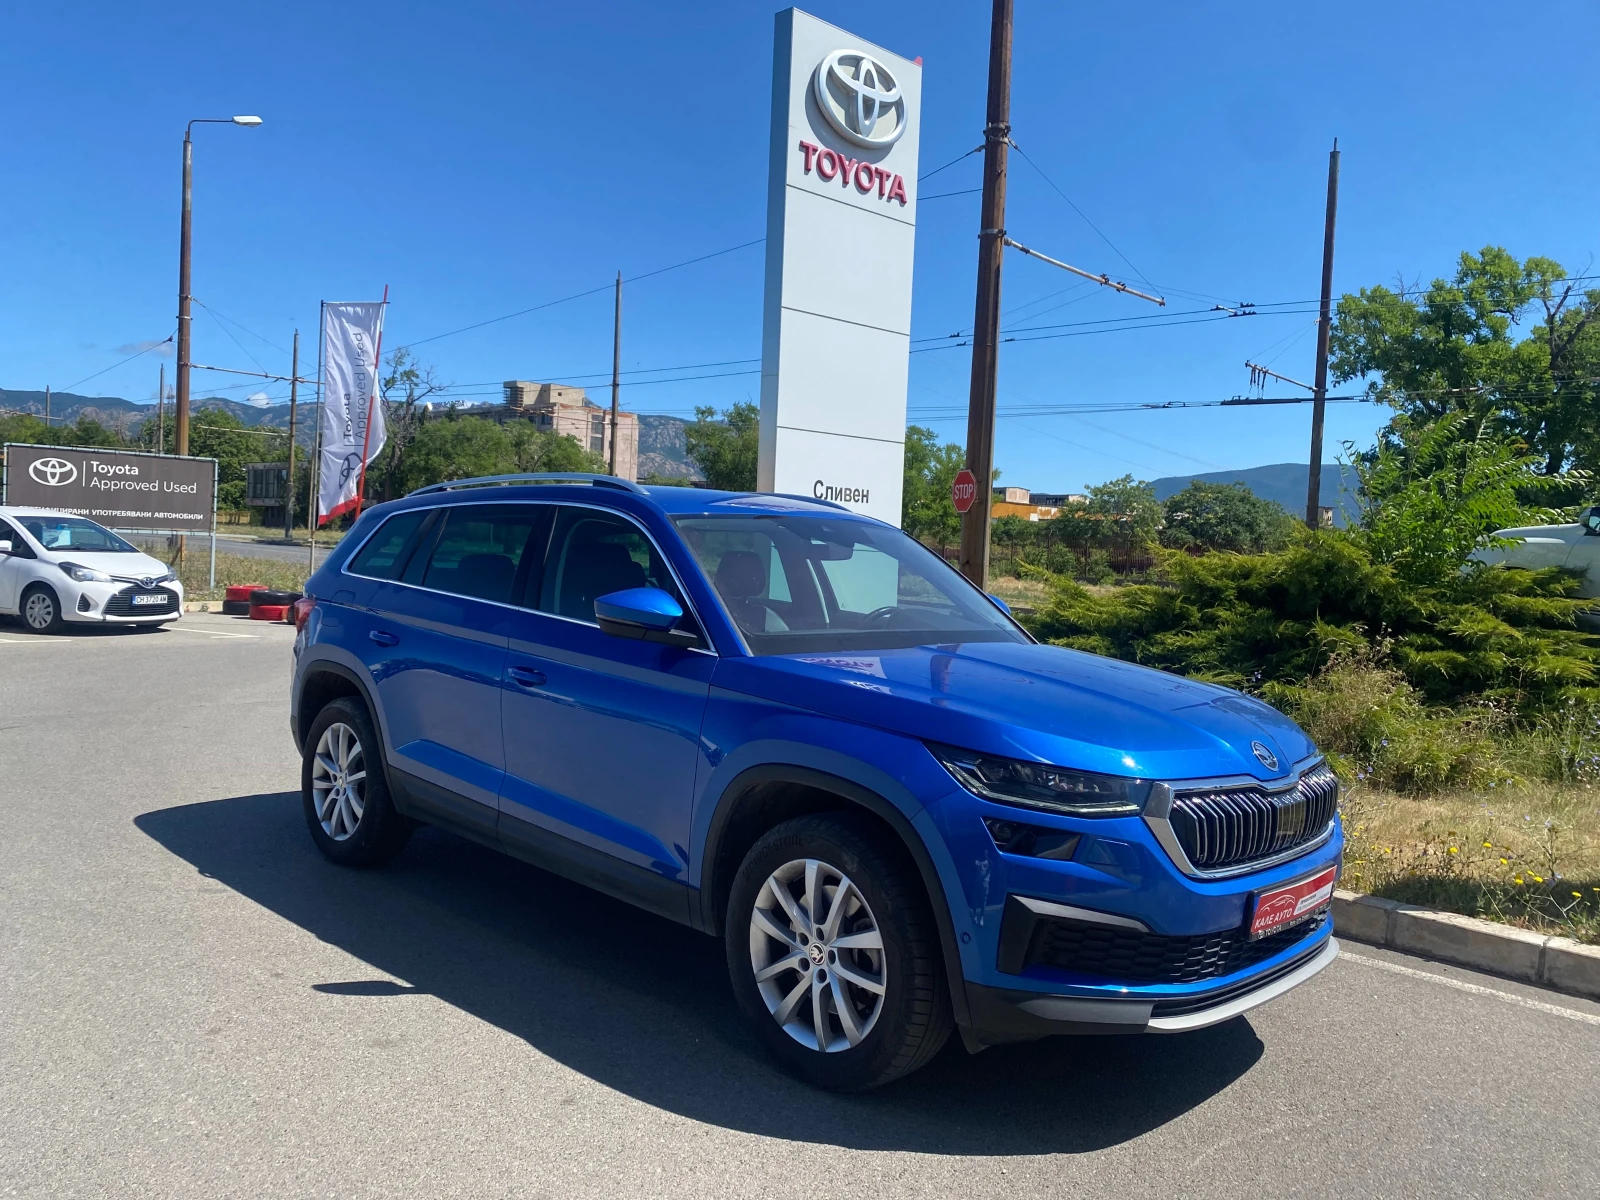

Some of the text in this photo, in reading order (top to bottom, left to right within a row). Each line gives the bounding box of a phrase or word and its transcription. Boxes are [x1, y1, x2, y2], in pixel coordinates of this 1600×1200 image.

[799, 139, 907, 205] TOYOTA
[353, 332, 367, 440] Approved Used
[343, 393, 352, 440] Toyota
[90, 461, 139, 476] Toyota
[89, 479, 197, 494] Approved Used
[813, 479, 870, 504] Сливен
[954, 483, 974, 499] STOP
[19, 505, 203, 520] ФИЦИРАНИ УПОТРЕБЯВАНИ АВТОМОБИЛИ
[1254, 914, 1275, 929] КАЛЕ
[1275, 907, 1293, 922] АУТО
